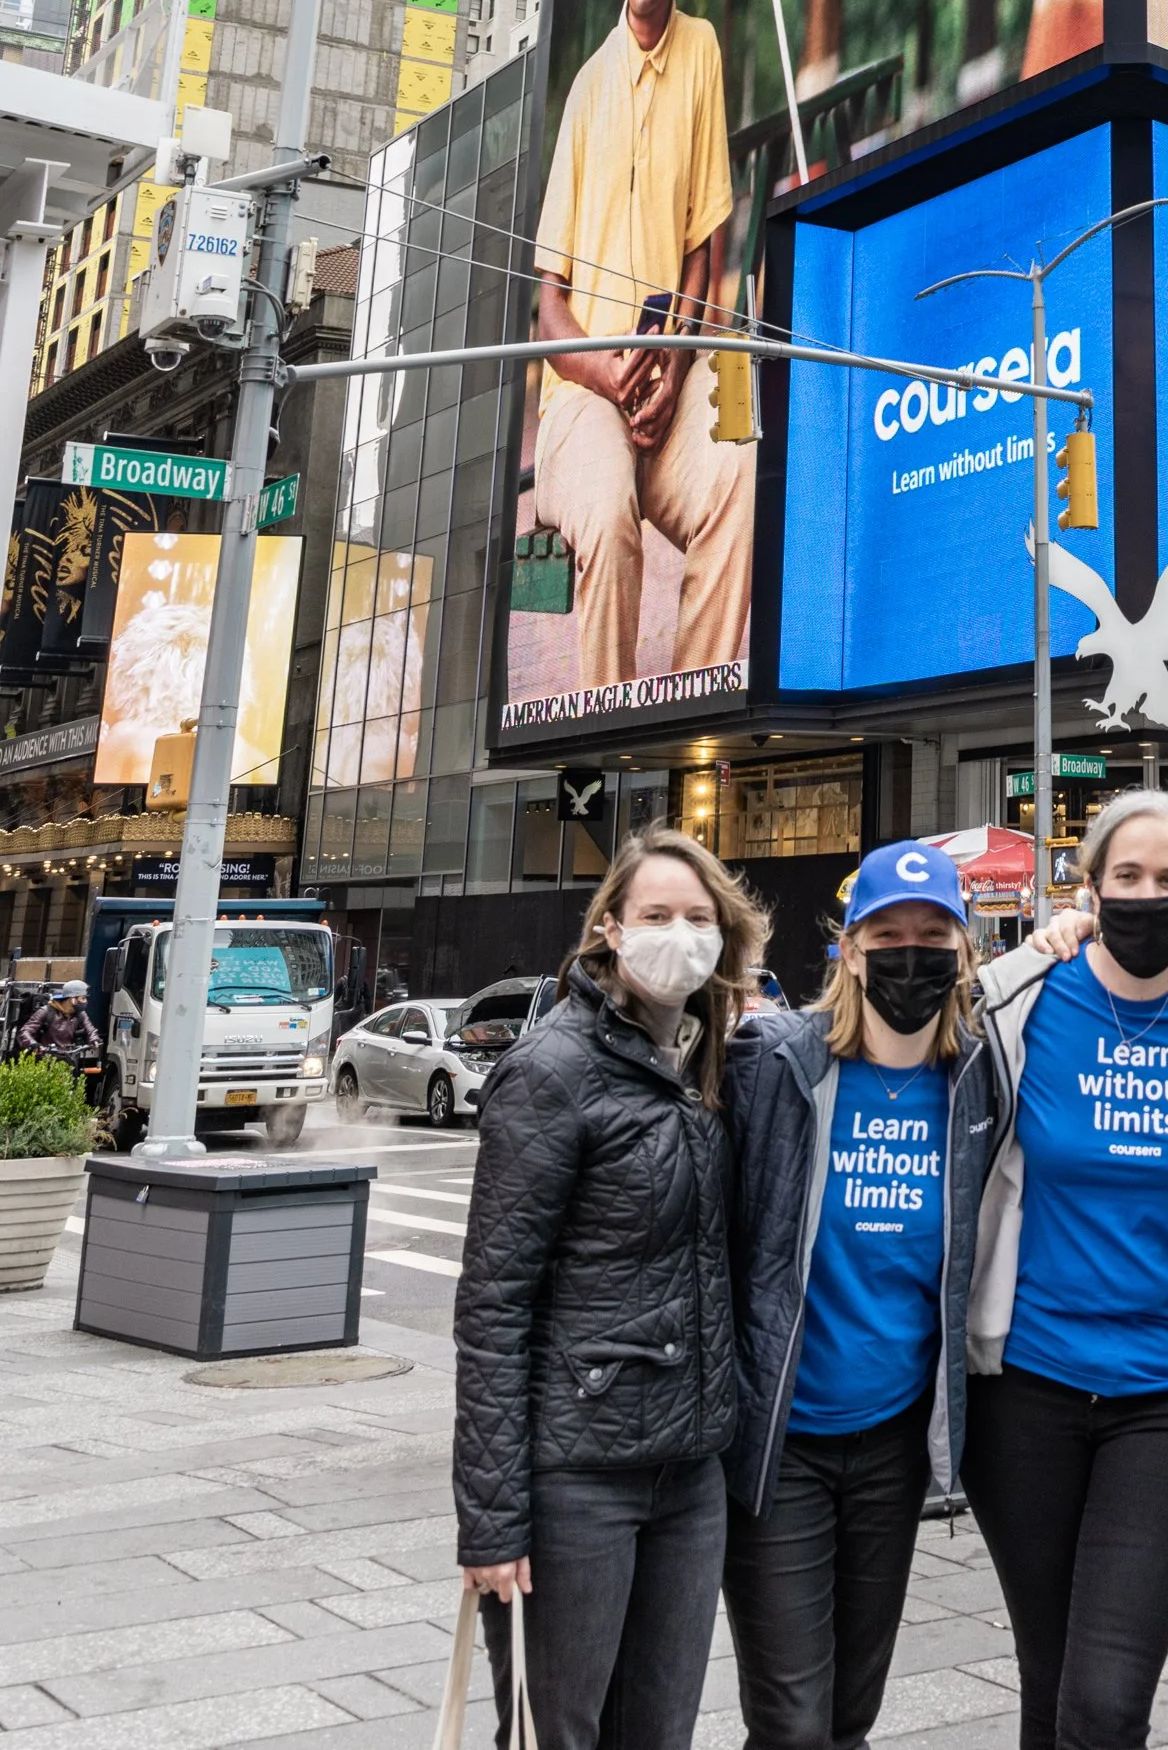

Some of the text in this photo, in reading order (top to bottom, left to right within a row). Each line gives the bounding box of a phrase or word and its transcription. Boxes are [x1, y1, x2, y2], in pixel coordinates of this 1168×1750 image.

[189, 234, 238, 257] 726162
[101, 453, 220, 499] Broadway
[893, 431, 1056, 495] Learn without lims
[259, 491, 269, 522] W
[271, 486, 285, 516] 46
[502, 662, 742, 730] AMERICAN EAGLE OUTFITTERS
[13, 735, 48, 762] AUDIENCE
[49, 729, 67, 753] WITH
[68, 726, 84, 748] THIS
[1062, 756, 1103, 777] Broadway
[1013, 780, 1020, 793] W
[1021, 778, 1030, 792] 46
[230, 873, 250, 881] ADORE
[896, 852, 930, 882] C
[995, 881, 1021, 890] thirsty?
[224, 1034, 263, 1044] ISUZU
[852, 1112, 928, 1141] Learn
[832, 1144, 941, 1176] without
[1109, 1144, 1162, 1157] coursera
[844, 1178, 924, 1210] limits
[855, 1221, 904, 1233] coursera
